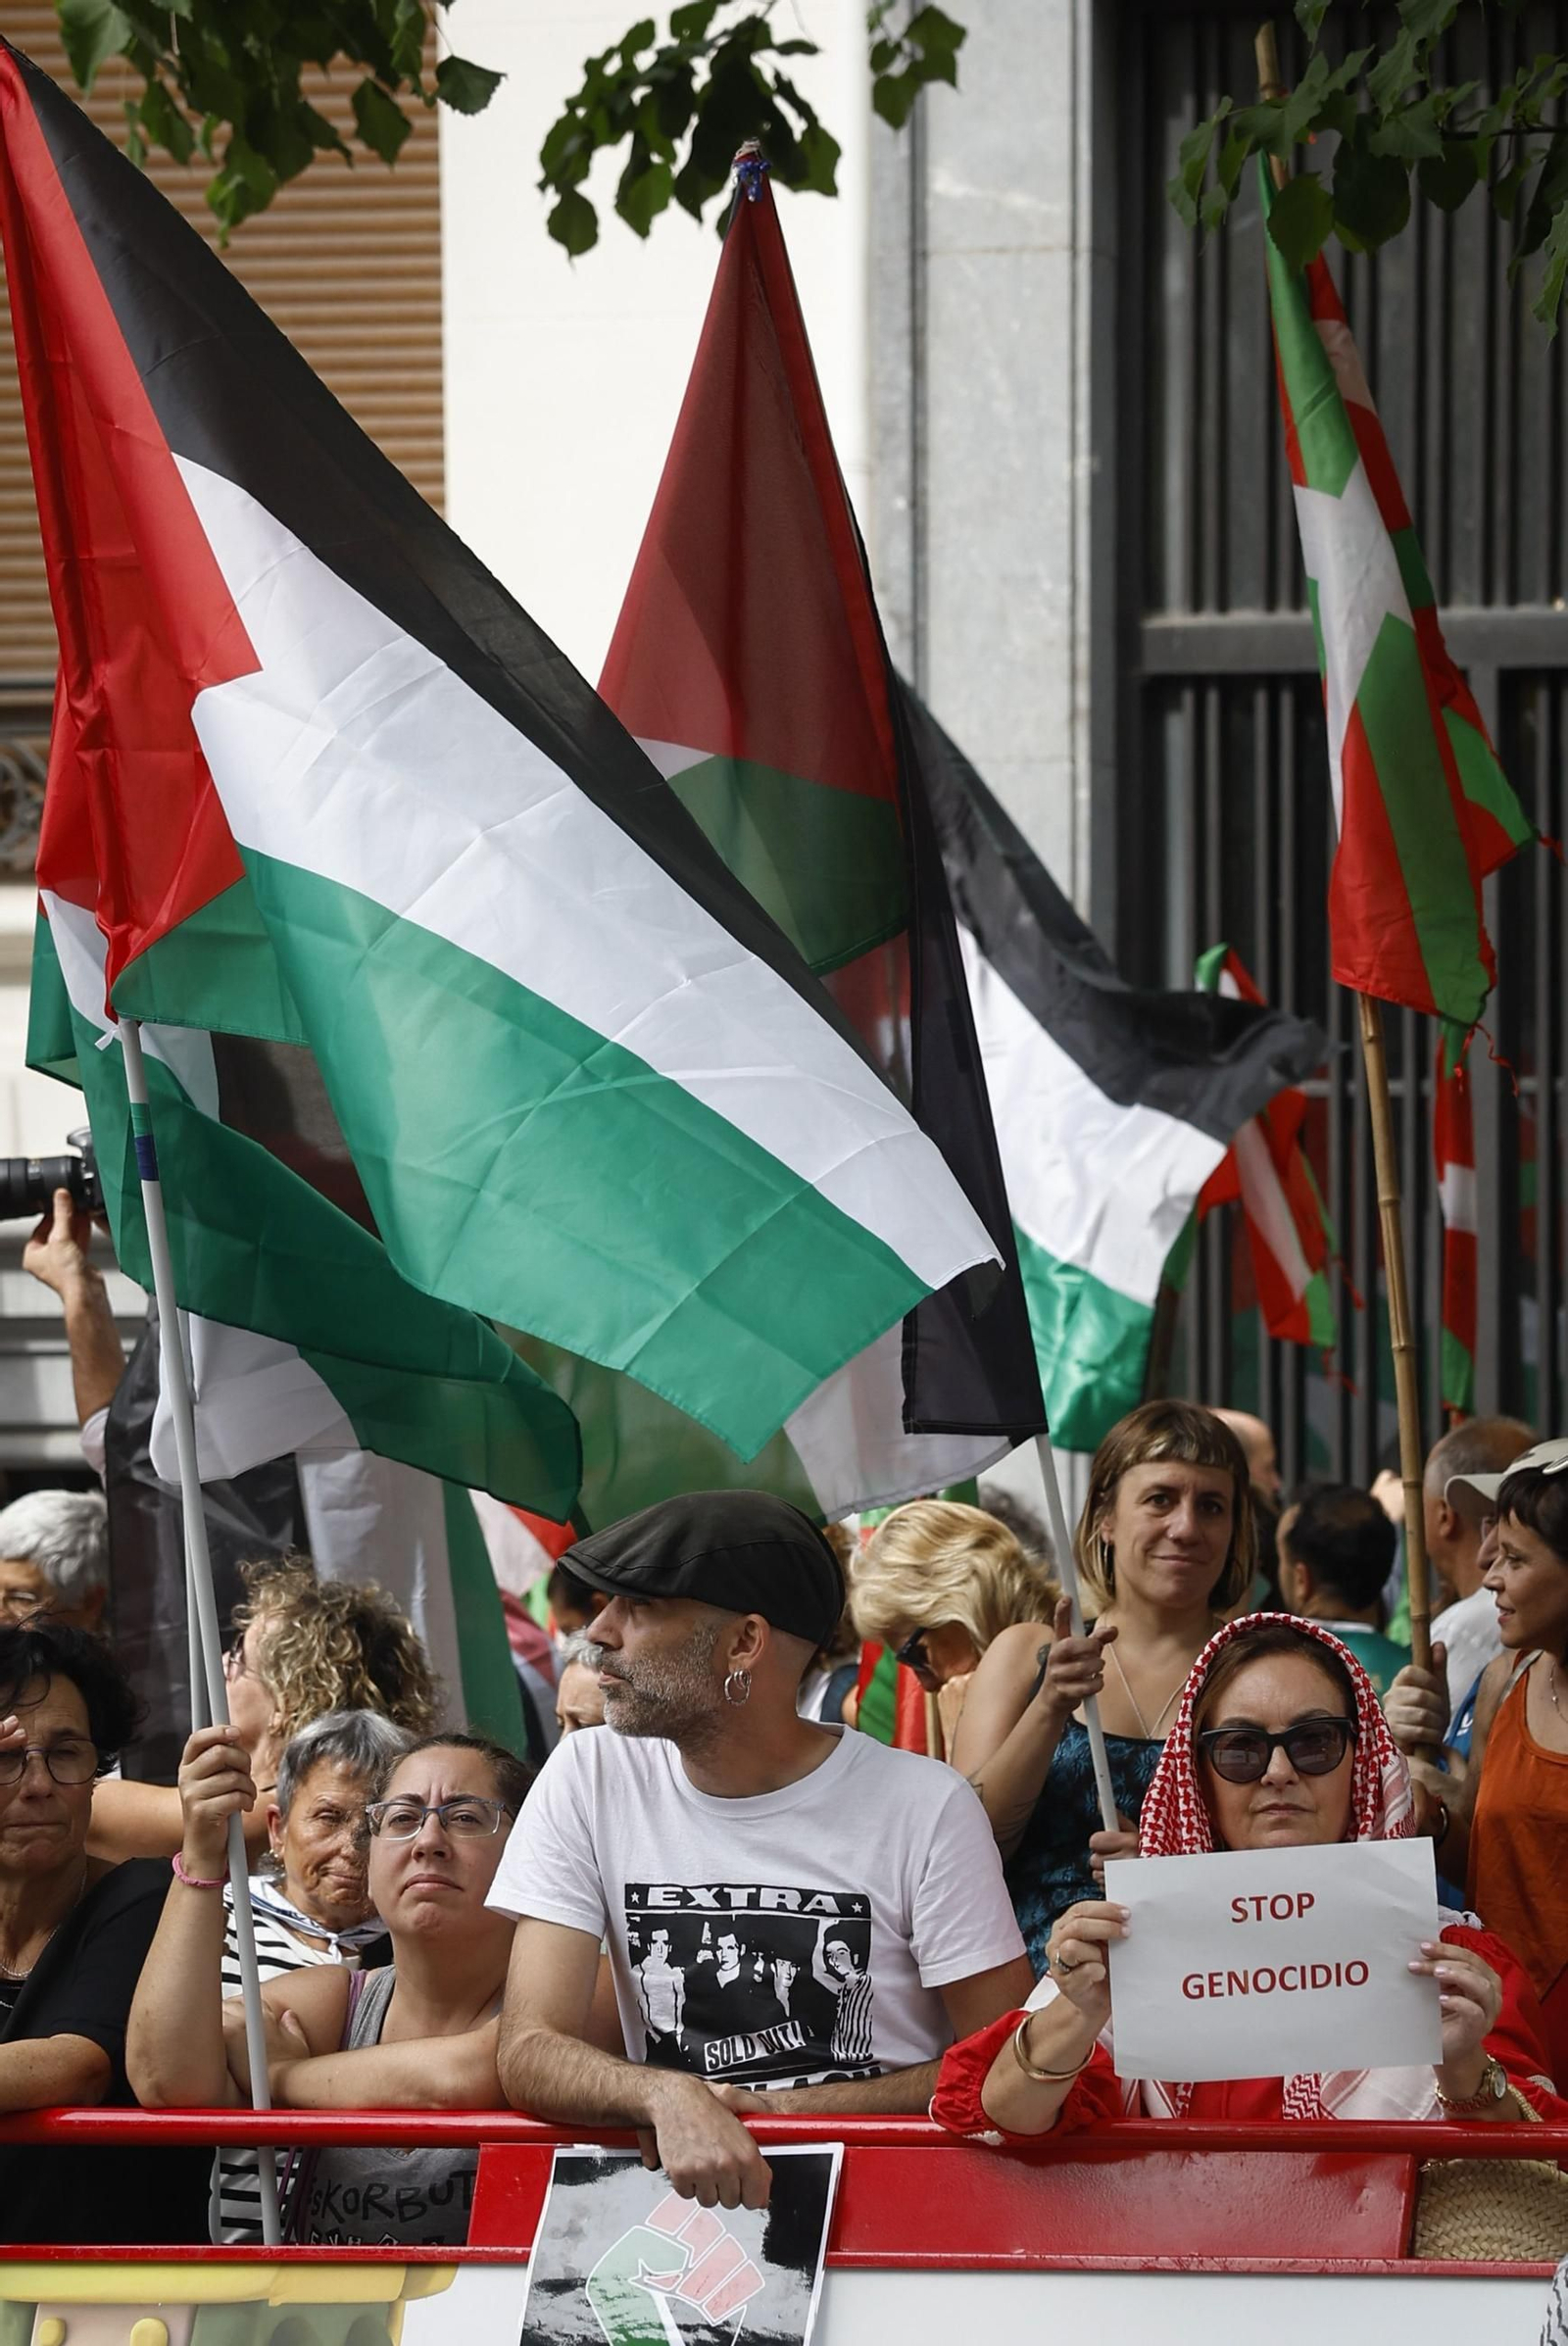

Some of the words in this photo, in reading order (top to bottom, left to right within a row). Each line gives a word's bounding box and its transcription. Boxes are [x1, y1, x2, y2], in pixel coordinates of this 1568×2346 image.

[647, 1886, 841, 1914] EXTRA
[1231, 1892, 1315, 1924] STOP
[1182, 1960, 1370, 2000] GENOCIDIO
[706, 2034, 757, 2070] SOLD
[759, 2022, 806, 2055] OUT!
[310, 2170, 477, 2224] SKORBUT
